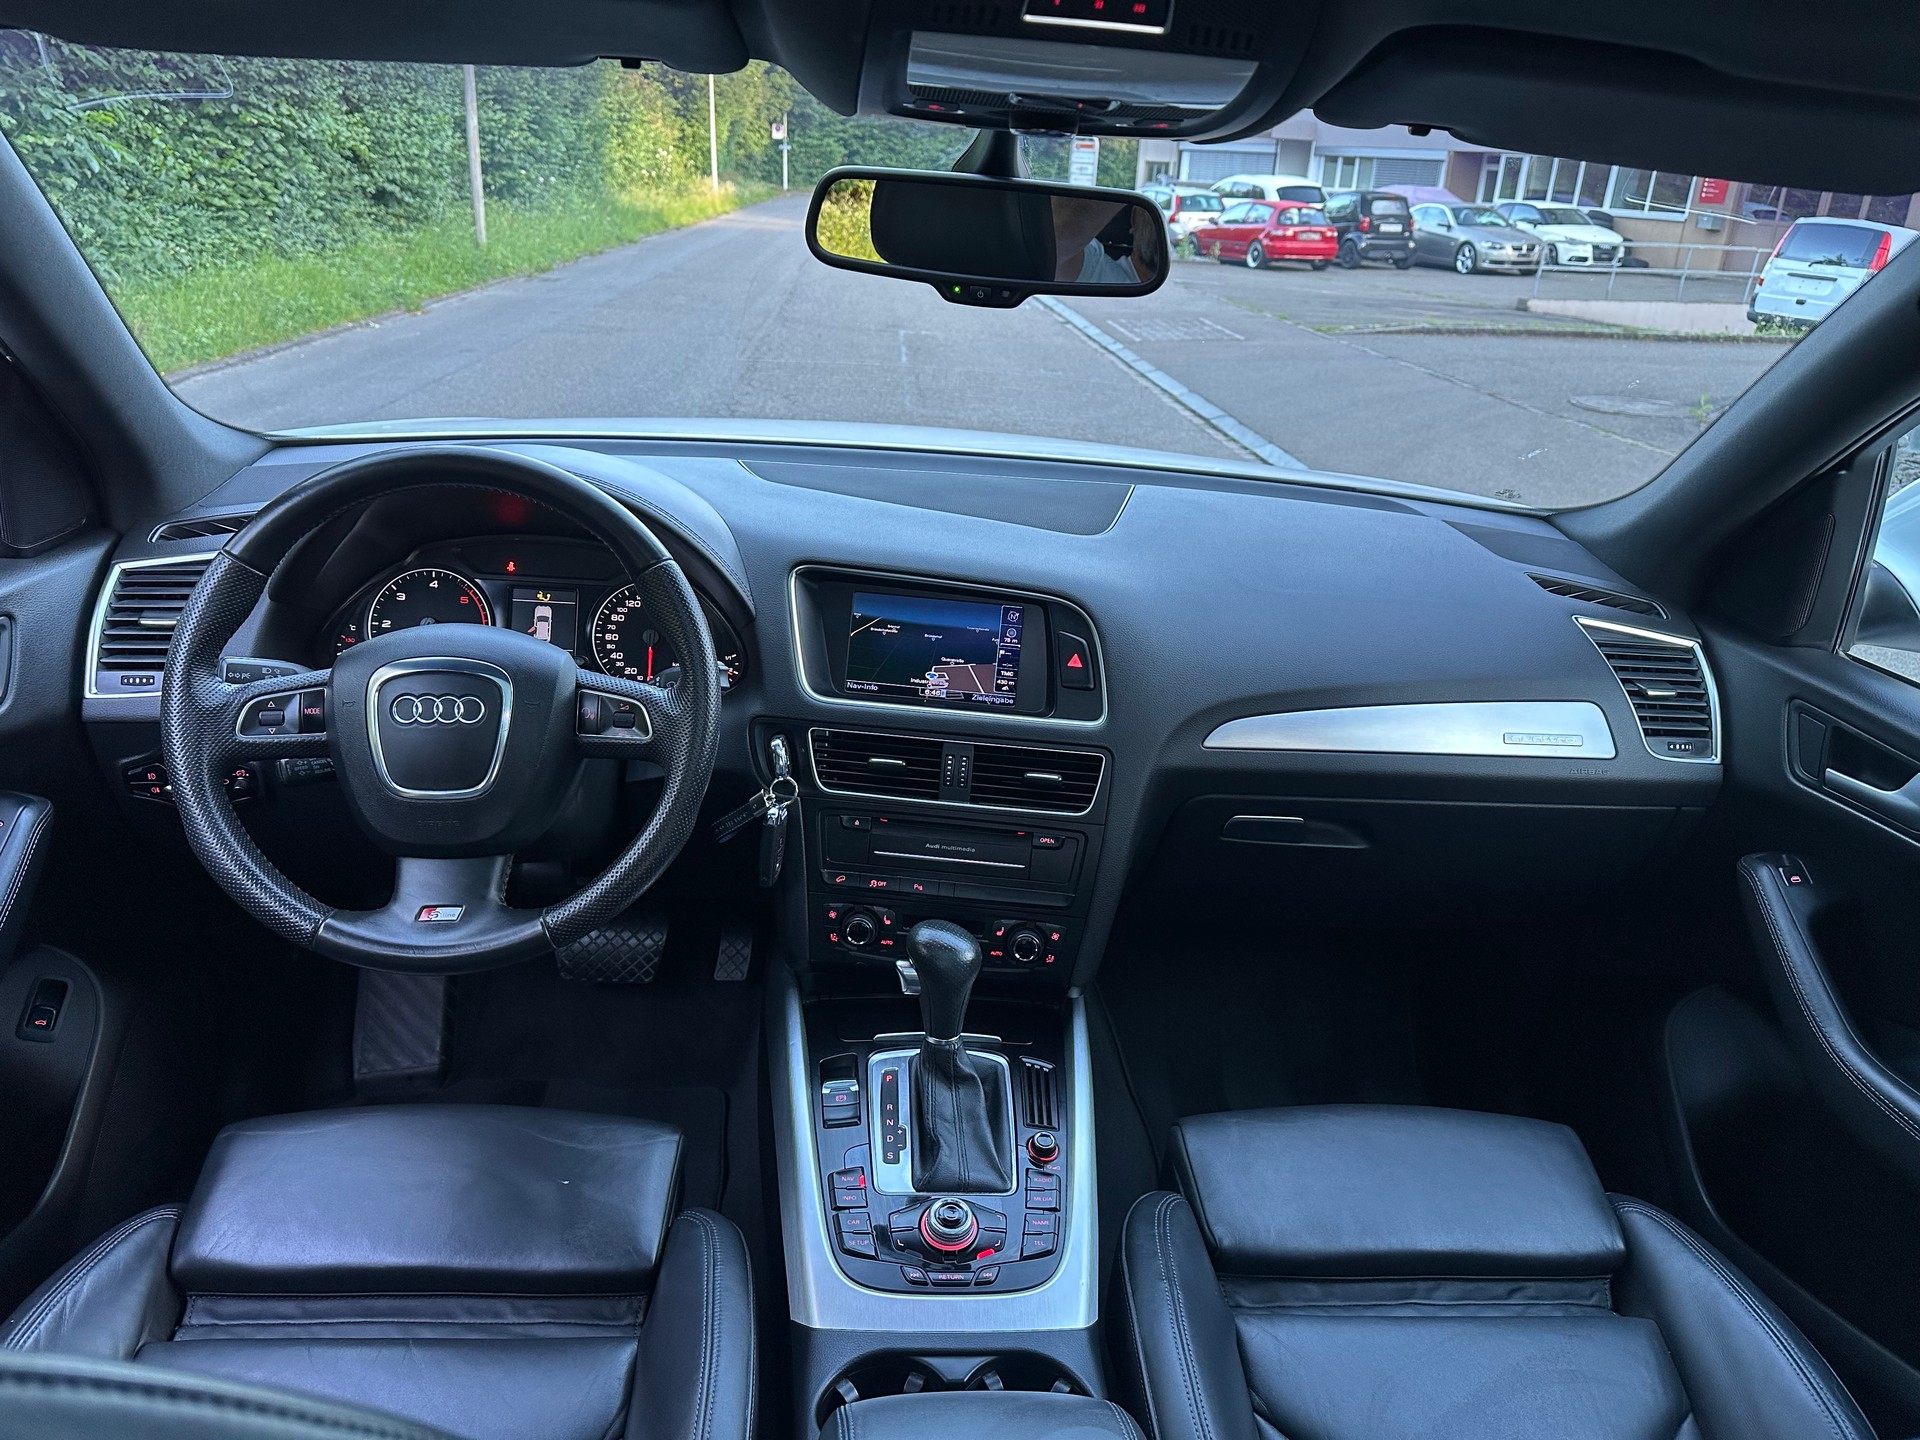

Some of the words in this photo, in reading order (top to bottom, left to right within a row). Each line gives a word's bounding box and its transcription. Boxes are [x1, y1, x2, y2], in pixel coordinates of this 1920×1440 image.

[429, 580, 438, 589] 4
[396, 592, 406, 601] 3
[459, 596, 469, 604] 5
[625, 600, 641, 608] 120
[611, 614, 625, 622] 80
[381, 620, 392, 628] 2
[624, 667, 638, 675] 20
[846, 681, 879, 691] Nav-Info
[971, 694, 1014, 704] Zieleingabe
[941, 845, 976, 853] multimedia
[886, 1103, 893, 1111] R
